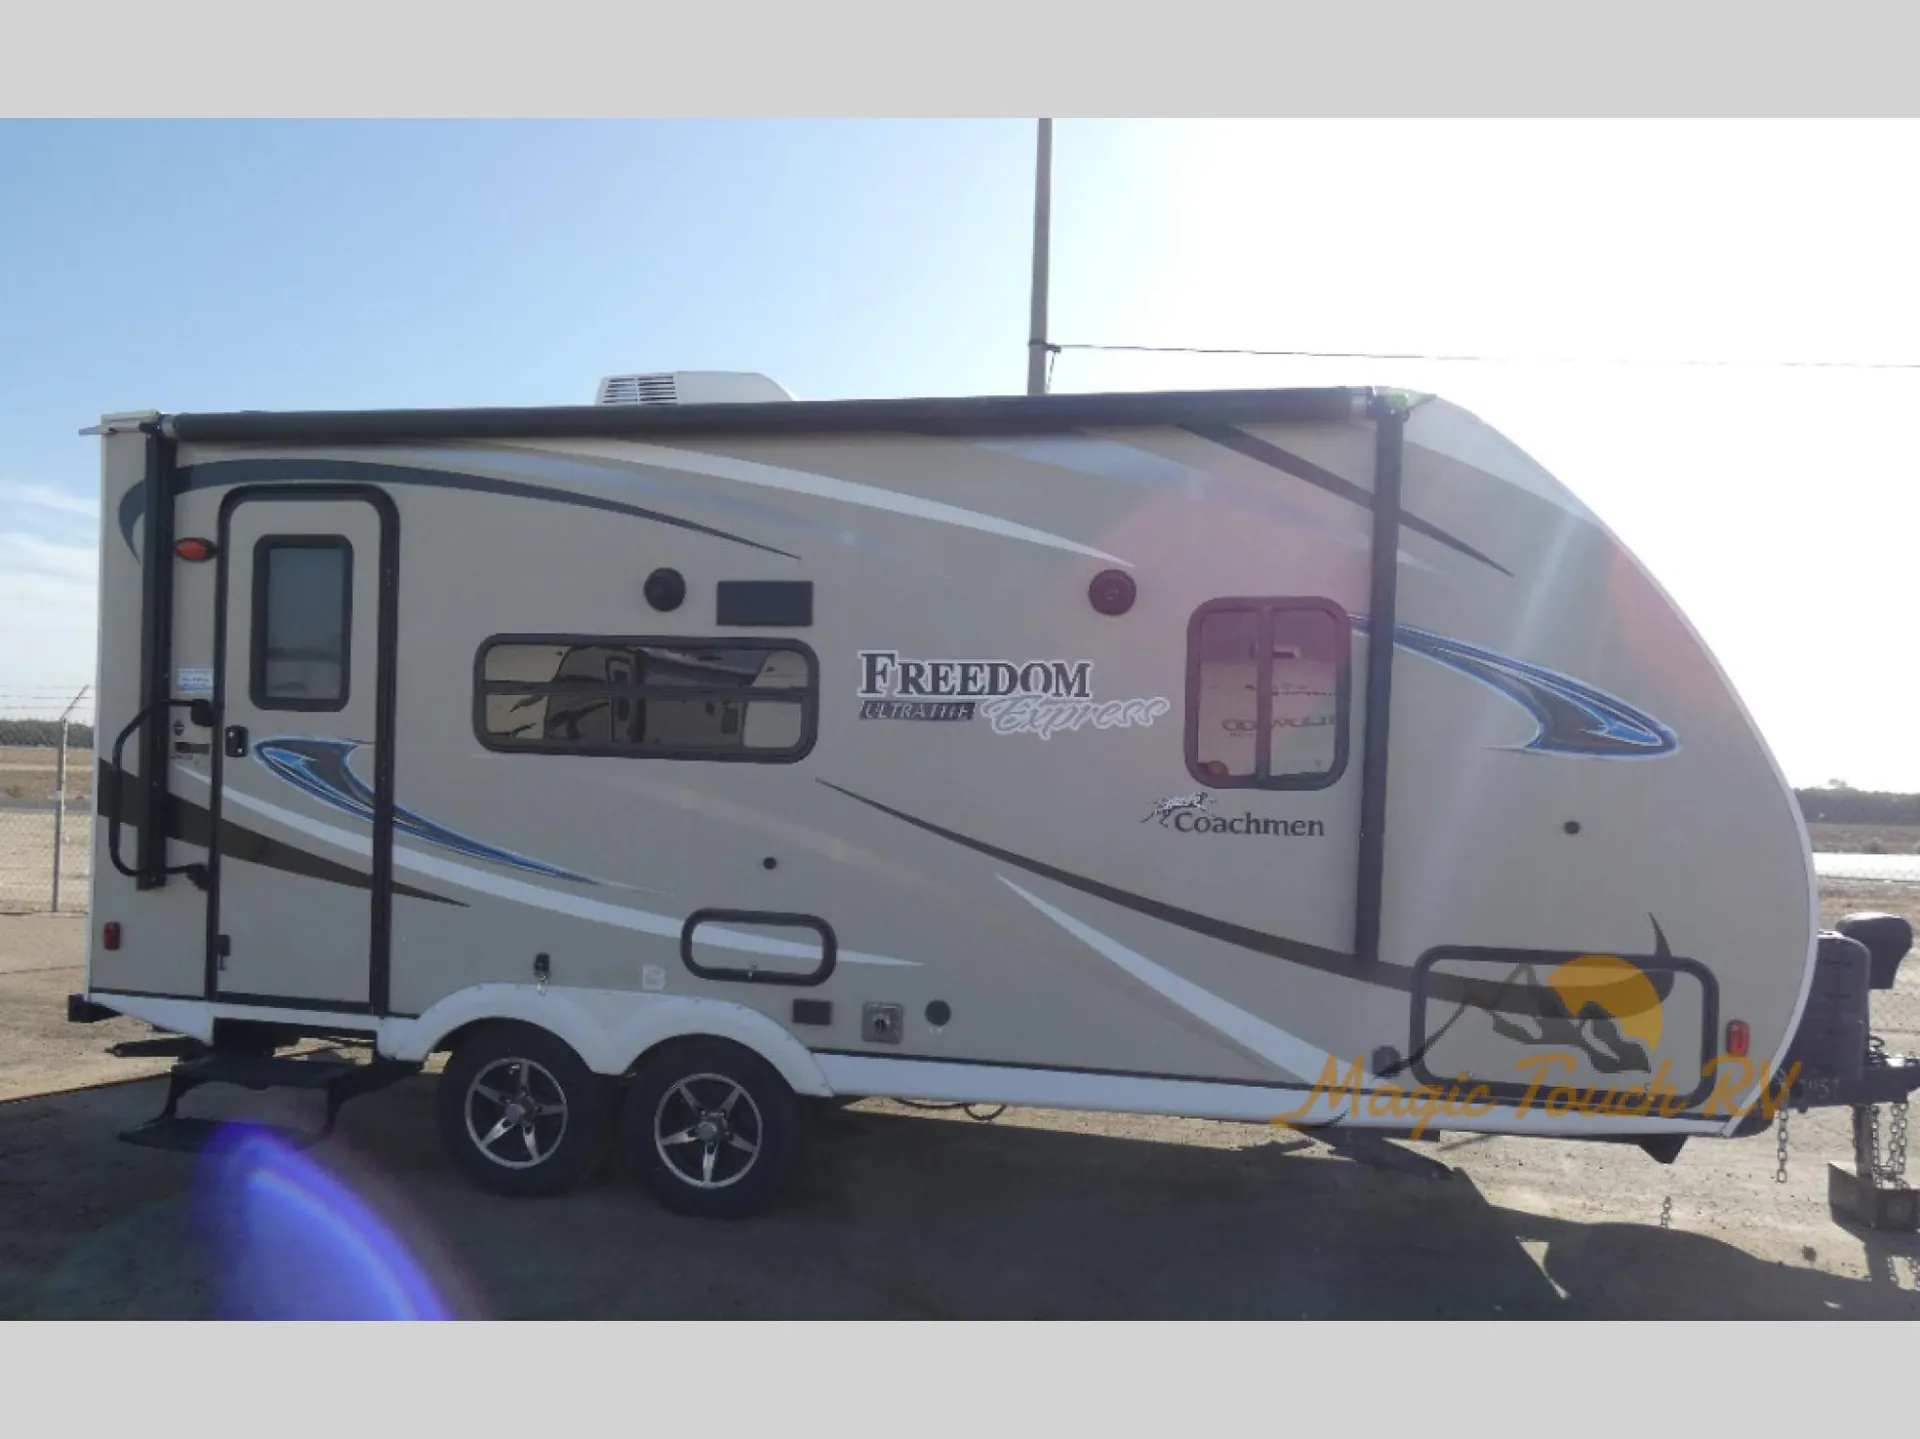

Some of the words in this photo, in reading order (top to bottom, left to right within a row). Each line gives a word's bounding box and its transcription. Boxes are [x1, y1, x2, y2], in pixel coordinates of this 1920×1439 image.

[858, 650, 1094, 699] FREEDOM
[980, 694, 1171, 740] Express
[1174, 812, 1325, 837] Coachmen
